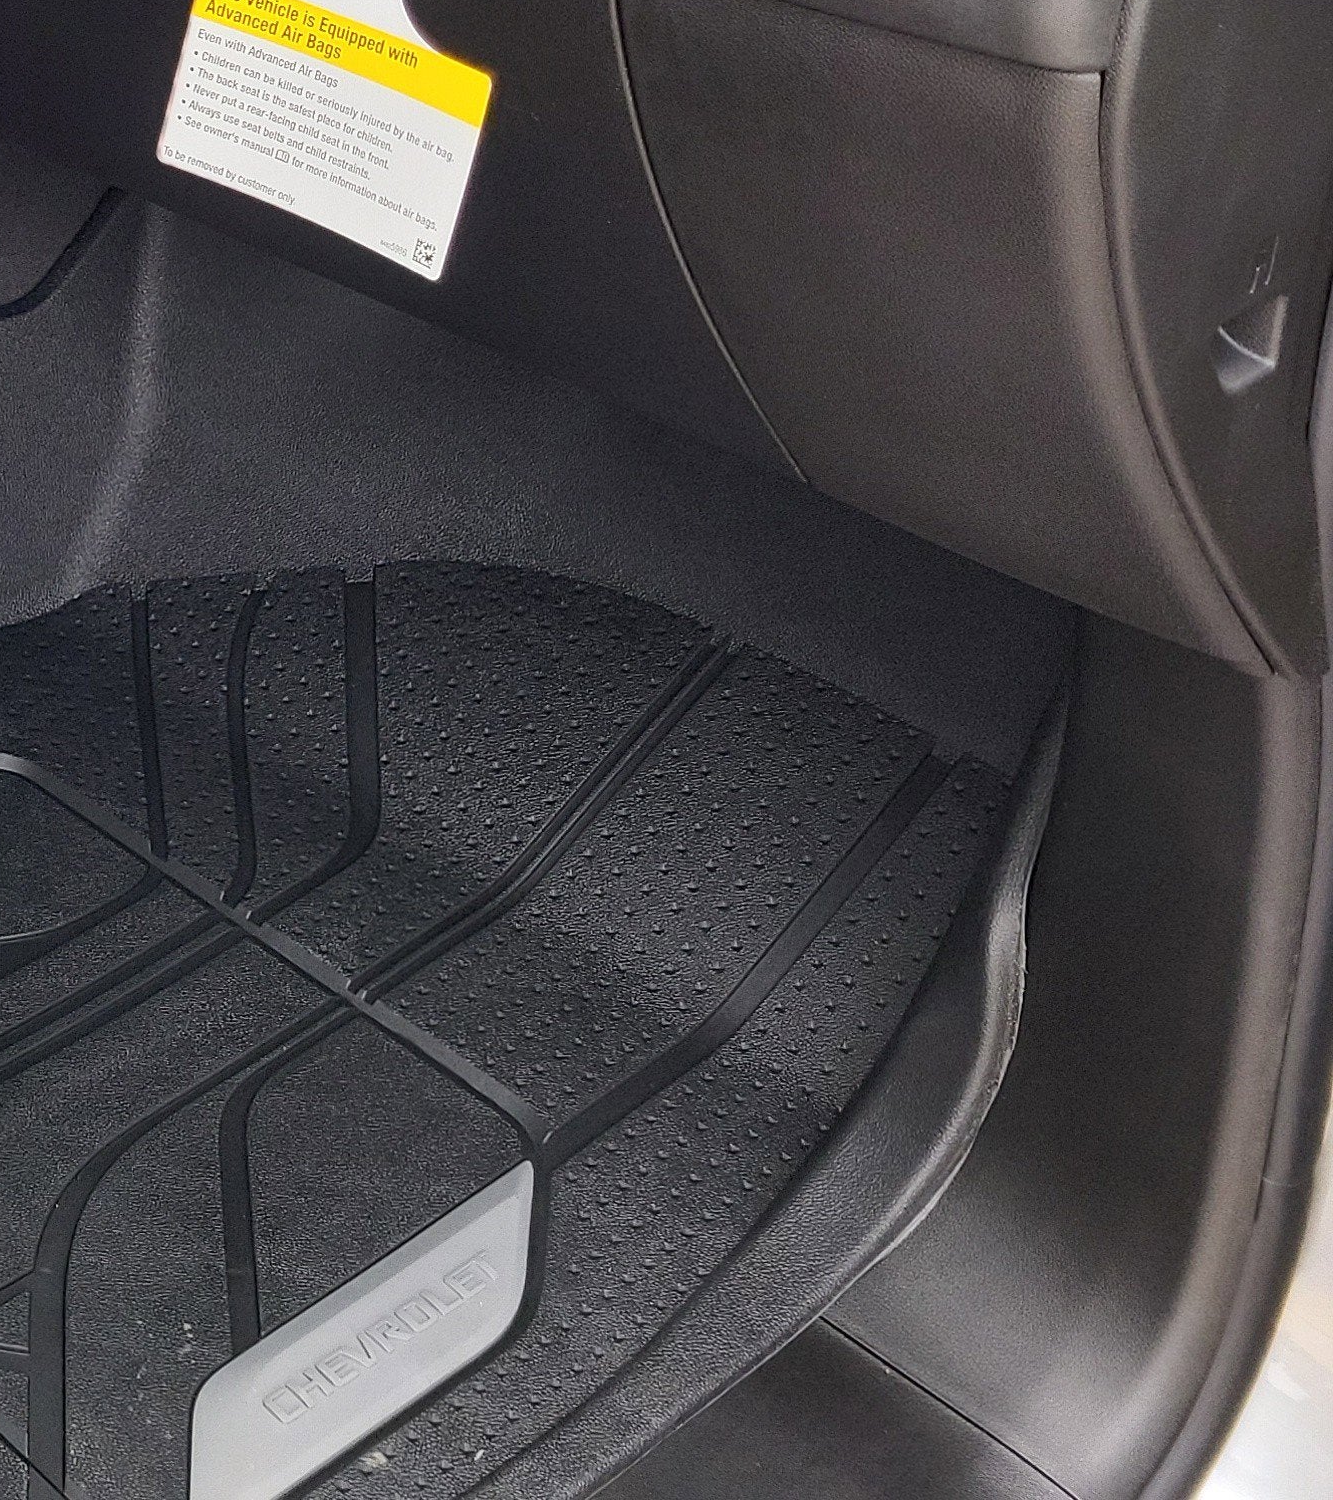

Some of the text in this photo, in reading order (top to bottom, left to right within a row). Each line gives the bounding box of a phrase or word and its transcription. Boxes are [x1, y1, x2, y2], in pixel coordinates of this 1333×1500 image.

[197, 28, 339, 88] Even with Advanced Air Bags
[205, 0, 342, 59] Advanced Air Bags
[303, 10, 315, 27] is
[319, 17, 385, 54] Equipped
[388, 46, 418, 68] with
[188, 100, 370, 180] Always use seat belts and child restraints.
[192, 83, 389, 170] Never put a rear-facing child seat in the front.
[197, 66, 393, 153] The back seat is the safest place for children.
[201, 51, 454, 163] Children can be killed or seriously injured by the air bag.
[163, 145, 296, 206] To be removed by customer only
[184, 115, 437, 232] See owner's manual for more information about air bags.
[262, 1248, 499, 1425] CHEVROLET
